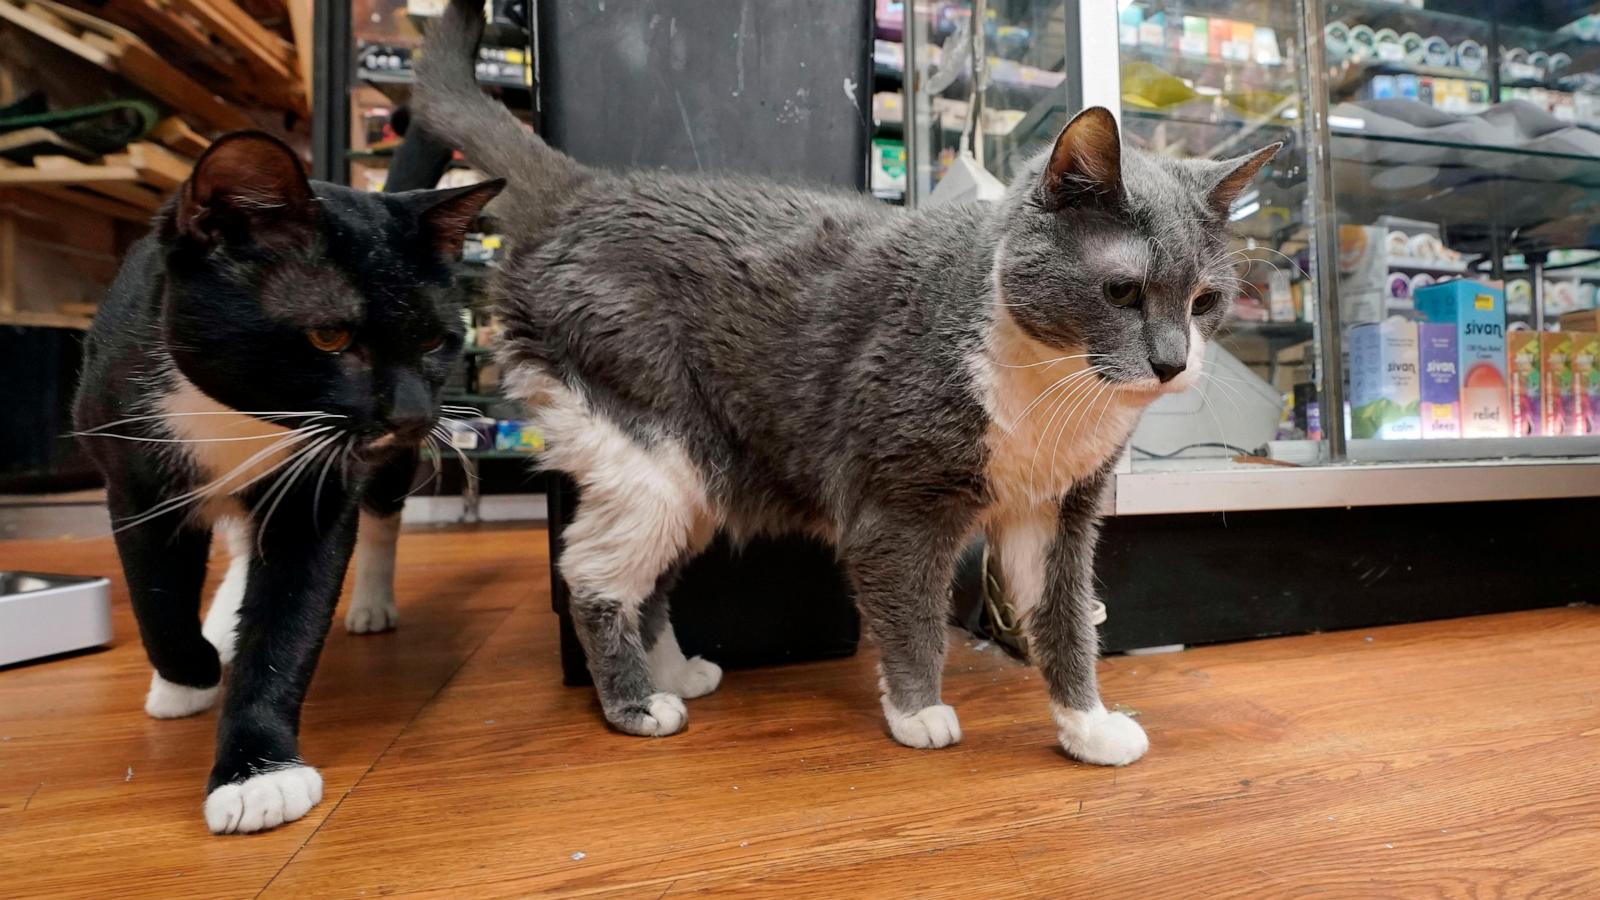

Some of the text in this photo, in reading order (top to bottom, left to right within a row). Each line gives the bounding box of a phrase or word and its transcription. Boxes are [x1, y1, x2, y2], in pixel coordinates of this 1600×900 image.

[1464, 320, 1503, 338] sivan
[1387, 361, 1416, 374] sivan
[1426, 360, 1456, 374] sivan
[1473, 406, 1500, 421] relief
[1391, 421, 1414, 432] calm
[1431, 420, 1456, 432] sleep
